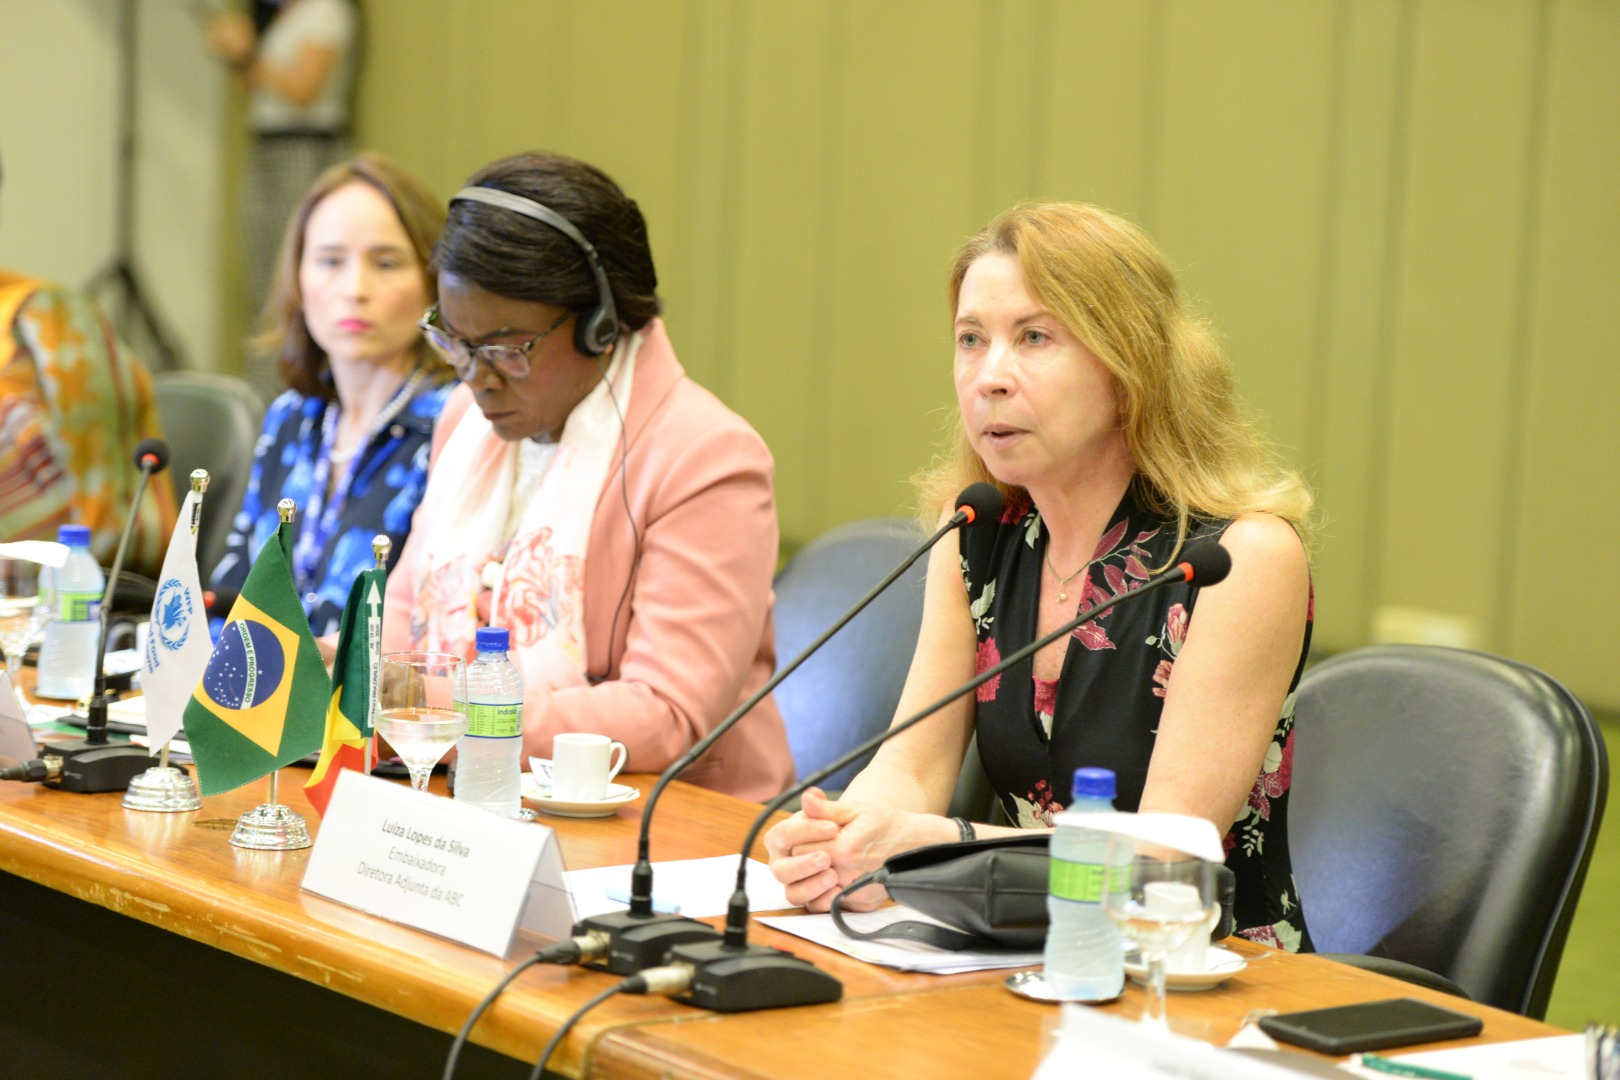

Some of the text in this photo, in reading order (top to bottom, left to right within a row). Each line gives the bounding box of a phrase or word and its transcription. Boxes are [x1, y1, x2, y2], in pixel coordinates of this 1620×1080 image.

[240, 622, 252, 651] ORDEM
[244, 656, 255, 703] PROGRESSO
[382, 819, 470, 858] Luiza Lopes da Silva
[388, 846, 446, 876] Embaixadora
[357, 861, 464, 908] Diretora Adjunta da ABC
